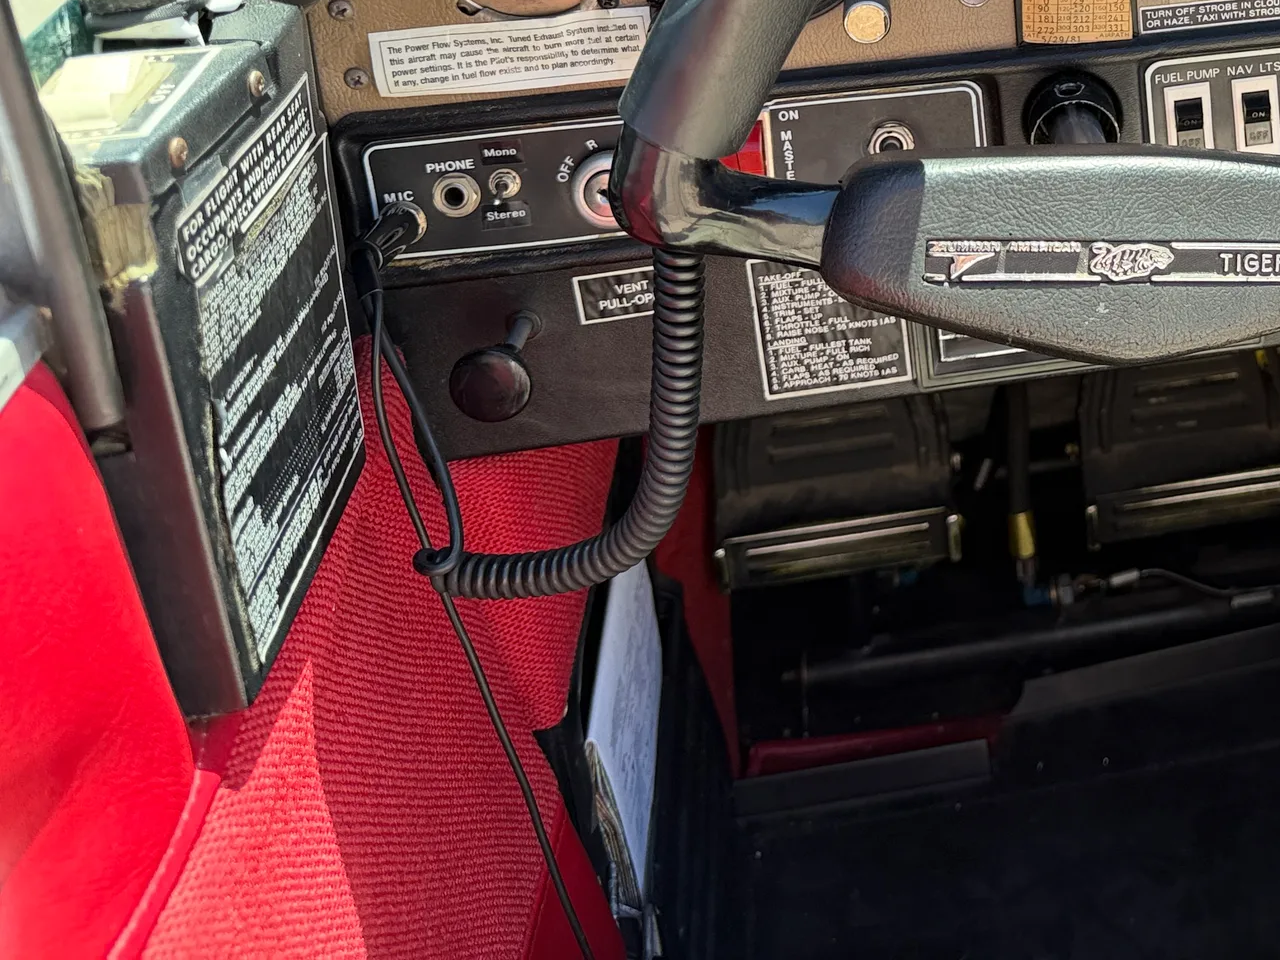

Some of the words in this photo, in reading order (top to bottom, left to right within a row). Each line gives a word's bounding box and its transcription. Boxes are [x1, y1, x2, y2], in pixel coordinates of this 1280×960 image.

[1145, 9, 1174, 19] TURN
[1176, 6, 1196, 16] OFF
[1199, 2, 1239, 13] STROBE
[1163, 15, 1194, 27] HAZE,
[1196, 12, 1219, 23] TAXI
[1221, 9, 1247, 20] WITH
[404, 43, 429, 54] Power
[508, 34, 532, 44] Tuned
[408, 53, 437, 63] aircraft
[1155, 70, 1184, 84] FUEL
[1186, 67, 1220, 80] PUMP
[1227, 64, 1254, 76] NAV
[778, 110, 799, 121] ON
[483, 147, 517, 157] Mono
[243, 150, 276, 193] AND/OR
[425, 158, 475, 173] PHONE
[555, 155, 575, 183] OFF
[182, 211, 206, 241] FOR
[204, 167, 239, 213] FLIGHT
[239, 143, 265, 177] WITH
[265, 114, 287, 144] REAR
[384, 190, 414, 203] MIC
[189, 234, 230, 279] CARGO,
[226, 194, 255, 239] CHECK
[252, 161, 282, 202] WEIGHT
[486, 209, 526, 221] Stereo
[758, 271, 802, 283] TAKE-OFF
[614, 280, 649, 295] VENT
[767, 337, 807, 348] LANDING
